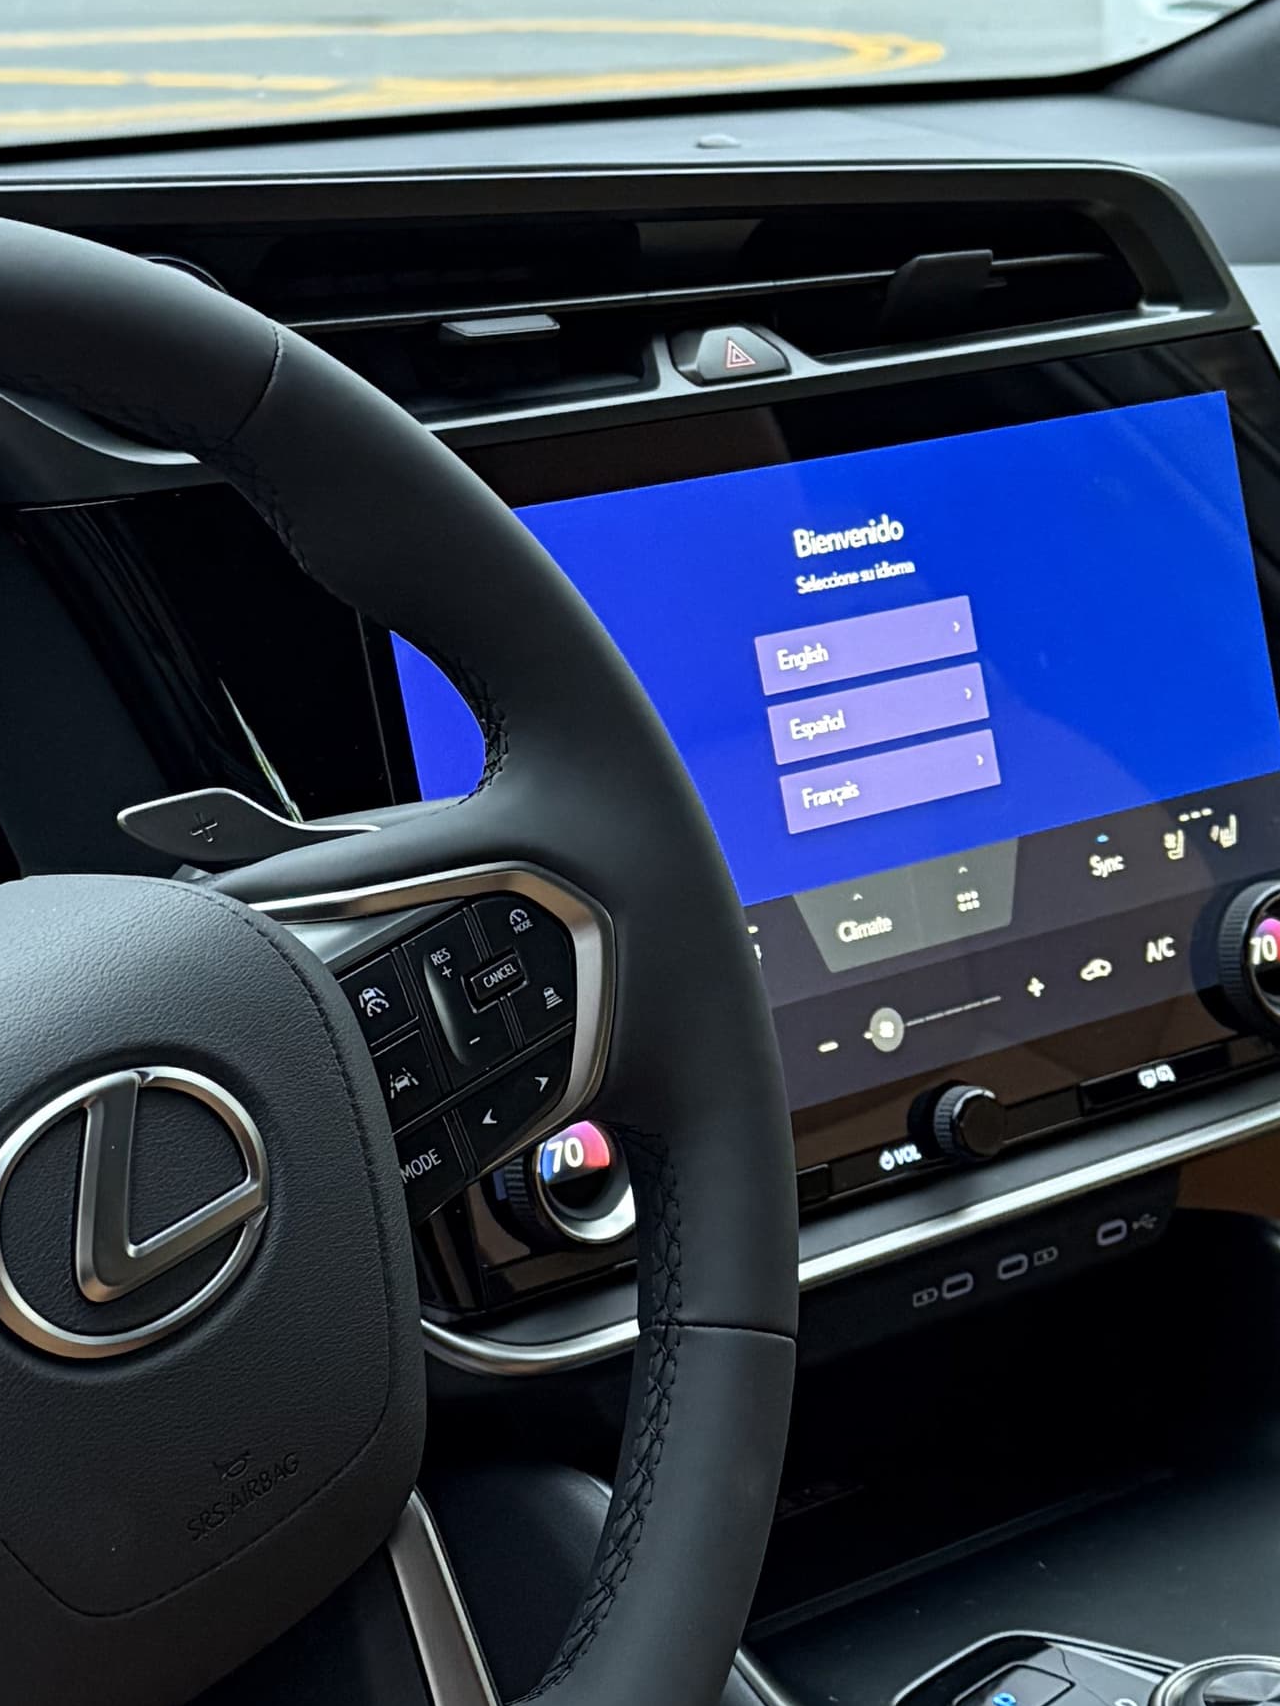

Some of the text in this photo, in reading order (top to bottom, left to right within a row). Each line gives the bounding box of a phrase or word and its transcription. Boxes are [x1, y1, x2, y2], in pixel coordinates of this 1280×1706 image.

[793, 513, 904, 558] Bienvenido
[795, 560, 916, 594] Seleccione su idioma
[776, 642, 830, 671] English
[789, 708, 846, 740] Español
[801, 780, 860, 809] Français
[1089, 854, 1125, 877] Sync
[837, 916, 893, 942] Climate
[430, 948, 451, 966] RES
[1145, 936, 1176, 962] A/C
[1249, 934, 1278, 965] 70
[482, 963, 517, 989] CANCEL
[400, 1148, 442, 1184] MODE
[546, 1136, 585, 1174] 70
[894, 1144, 922, 1165] VOL
[187, 1451, 300, 1541] SRS AIRBAG
